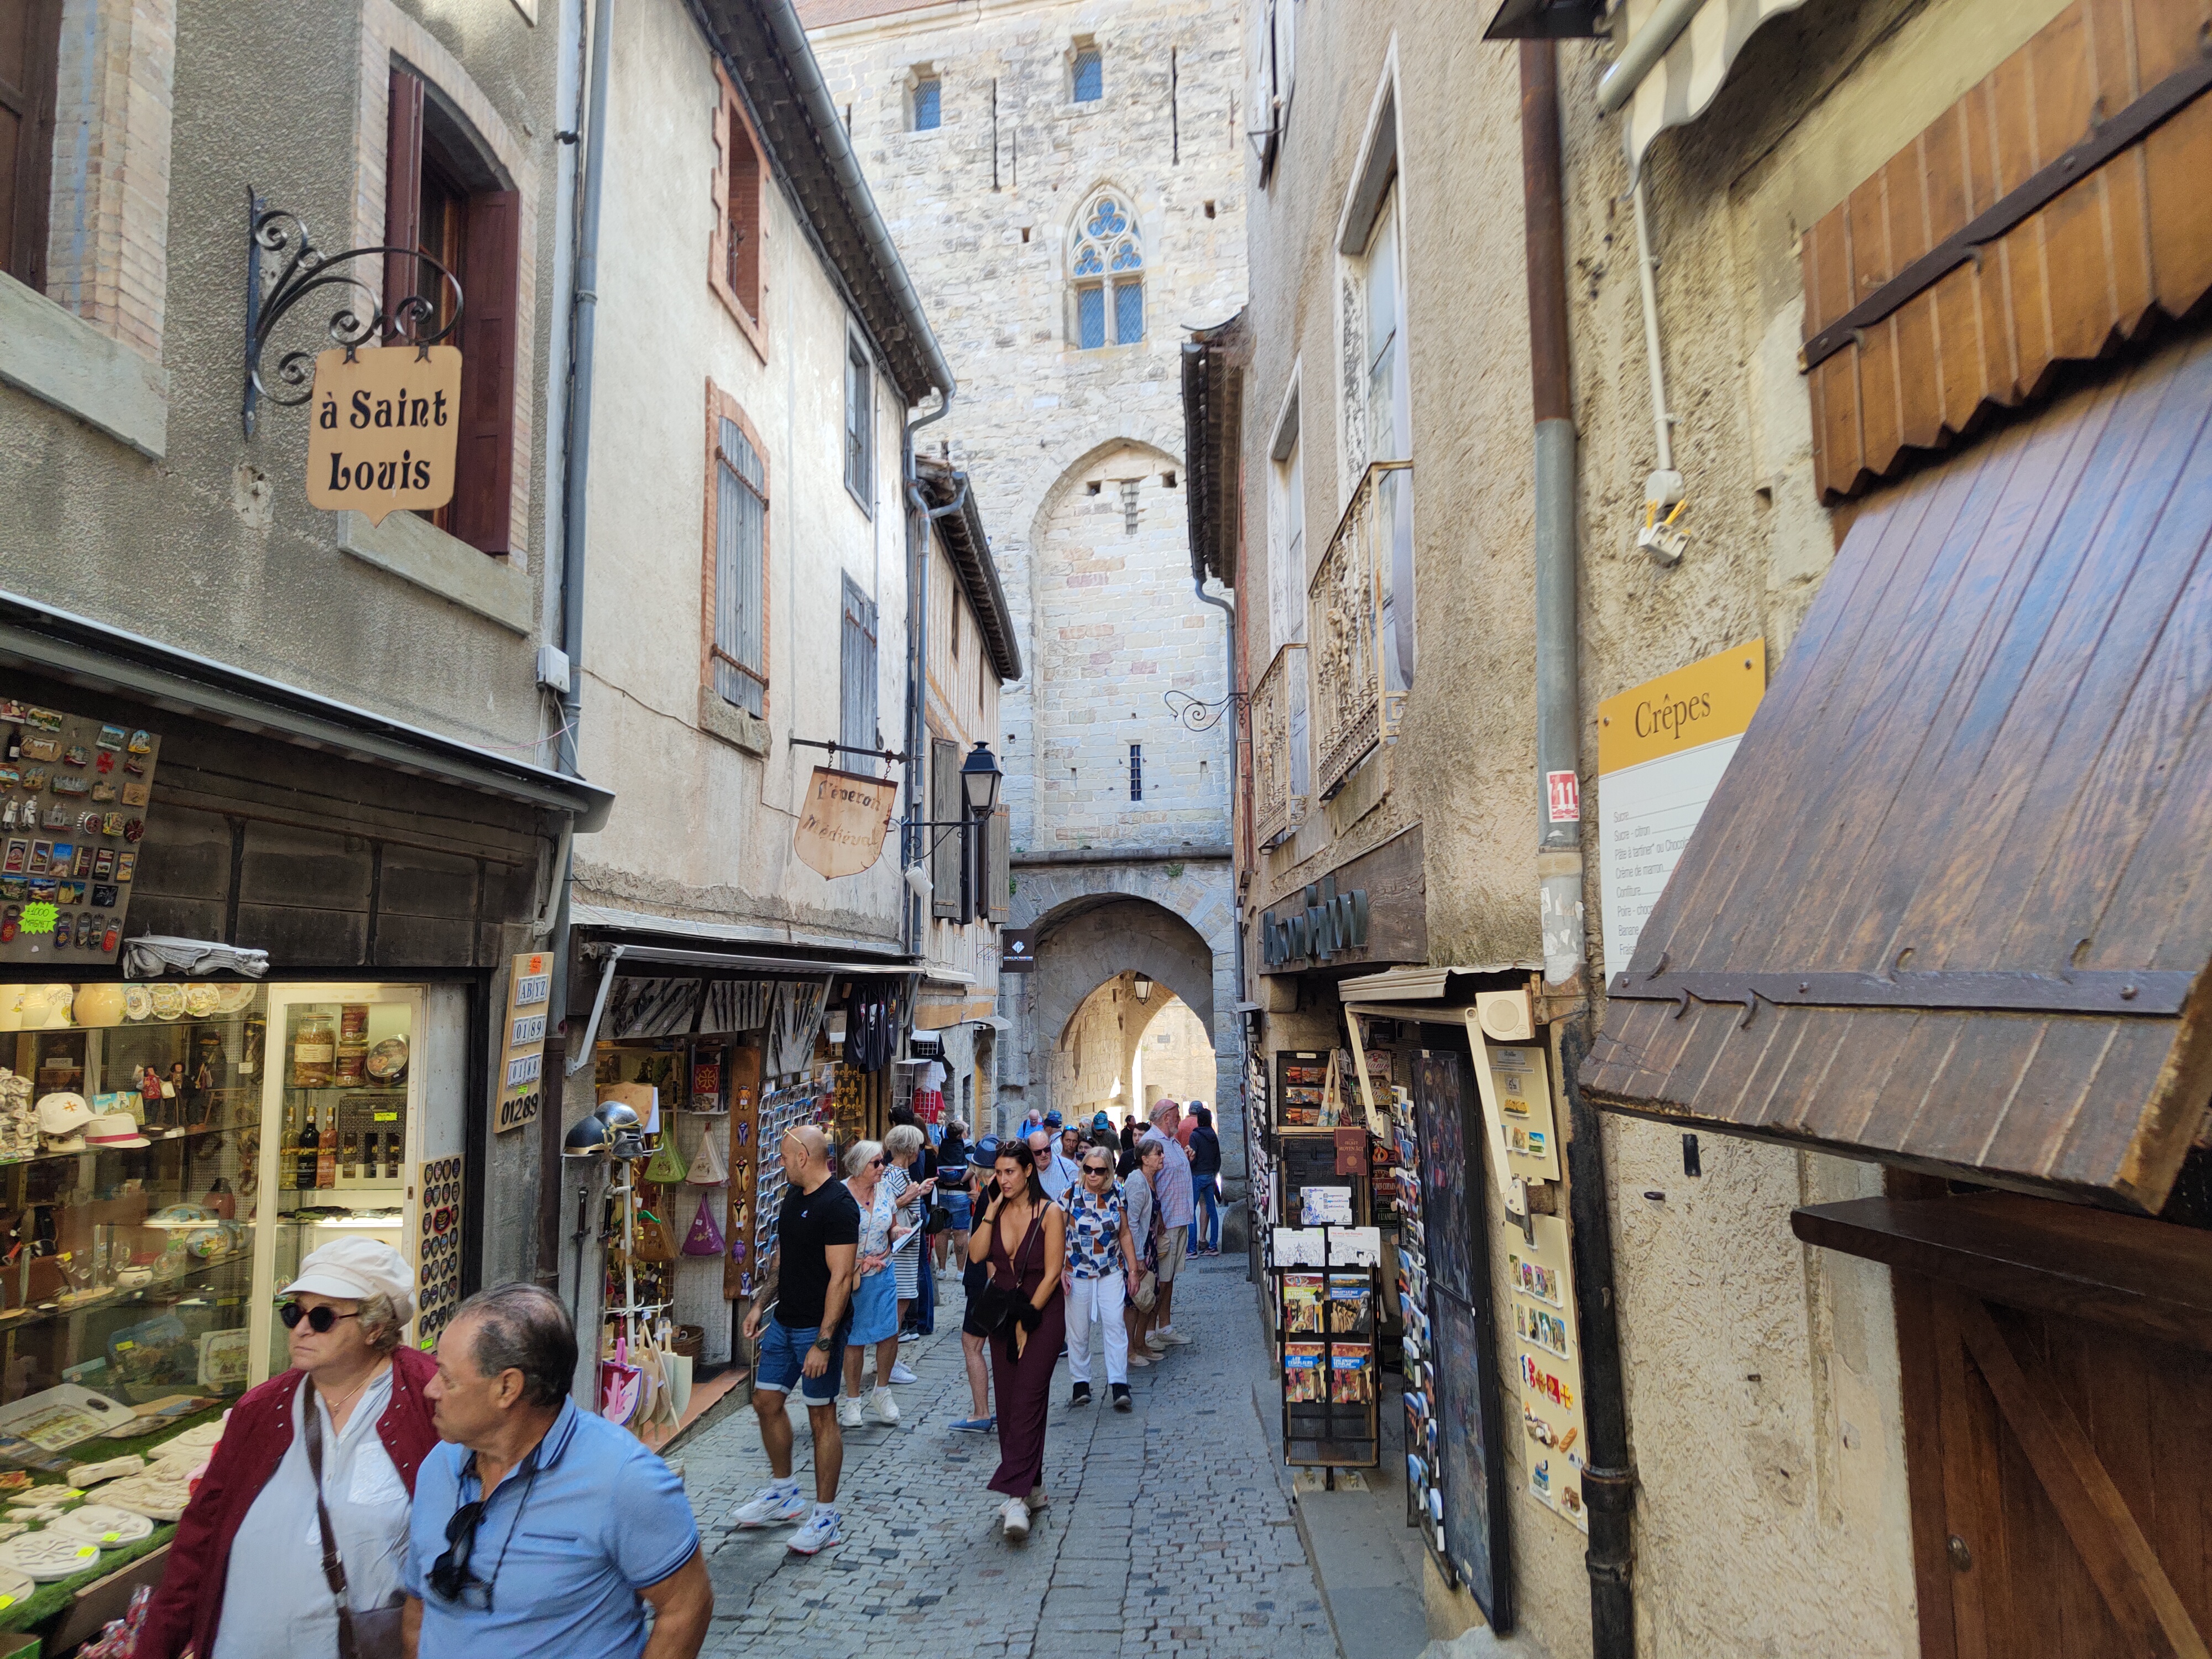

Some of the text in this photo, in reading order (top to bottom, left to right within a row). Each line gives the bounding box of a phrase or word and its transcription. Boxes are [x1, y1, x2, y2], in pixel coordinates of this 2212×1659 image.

[320, 388, 447, 430] à Saint
[328, 449, 431, 491] Louis
[1635, 691, 1712, 740] Crêpes
[1614, 830, 1630, 842] Sucre
[1635, 864, 1641, 877] de
[502, 1092, 539, 1125] 01289
